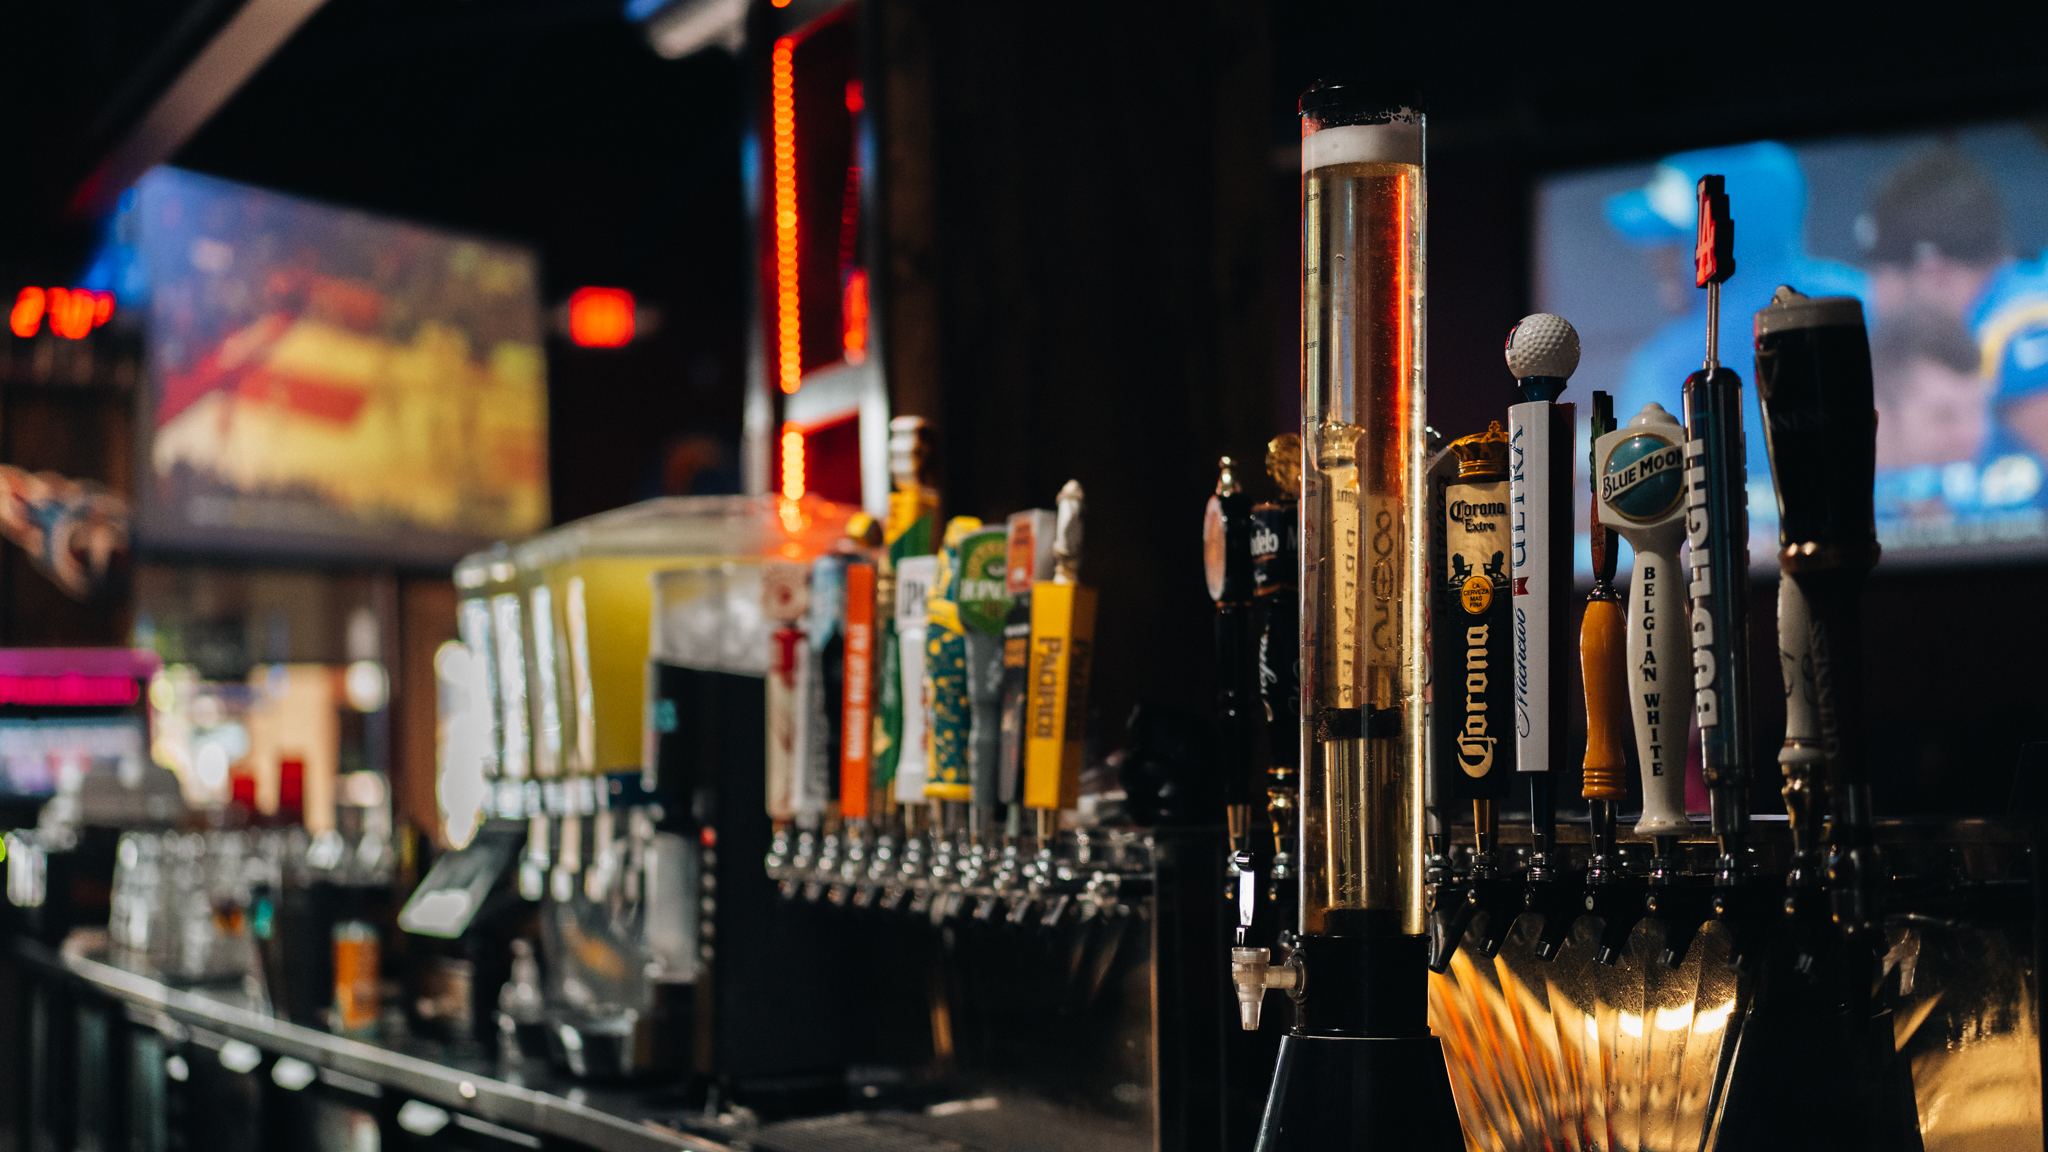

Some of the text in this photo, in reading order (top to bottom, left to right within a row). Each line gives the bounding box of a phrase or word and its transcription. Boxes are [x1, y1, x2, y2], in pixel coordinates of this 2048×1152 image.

[1449, 500, 1507, 522] Corona
[1465, 518, 1496, 532] Extra
[1510, 425, 1526, 569] ULTRA
[1602, 467, 1637, 500] BLUE
[1464, 588, 1490, 596] CERVEZA
[1684, 438, 1718, 728] BUD LIGHT
[1457, 624, 1497, 778] Corona
[1643, 566, 1664, 777] BELGIAN WHITE
